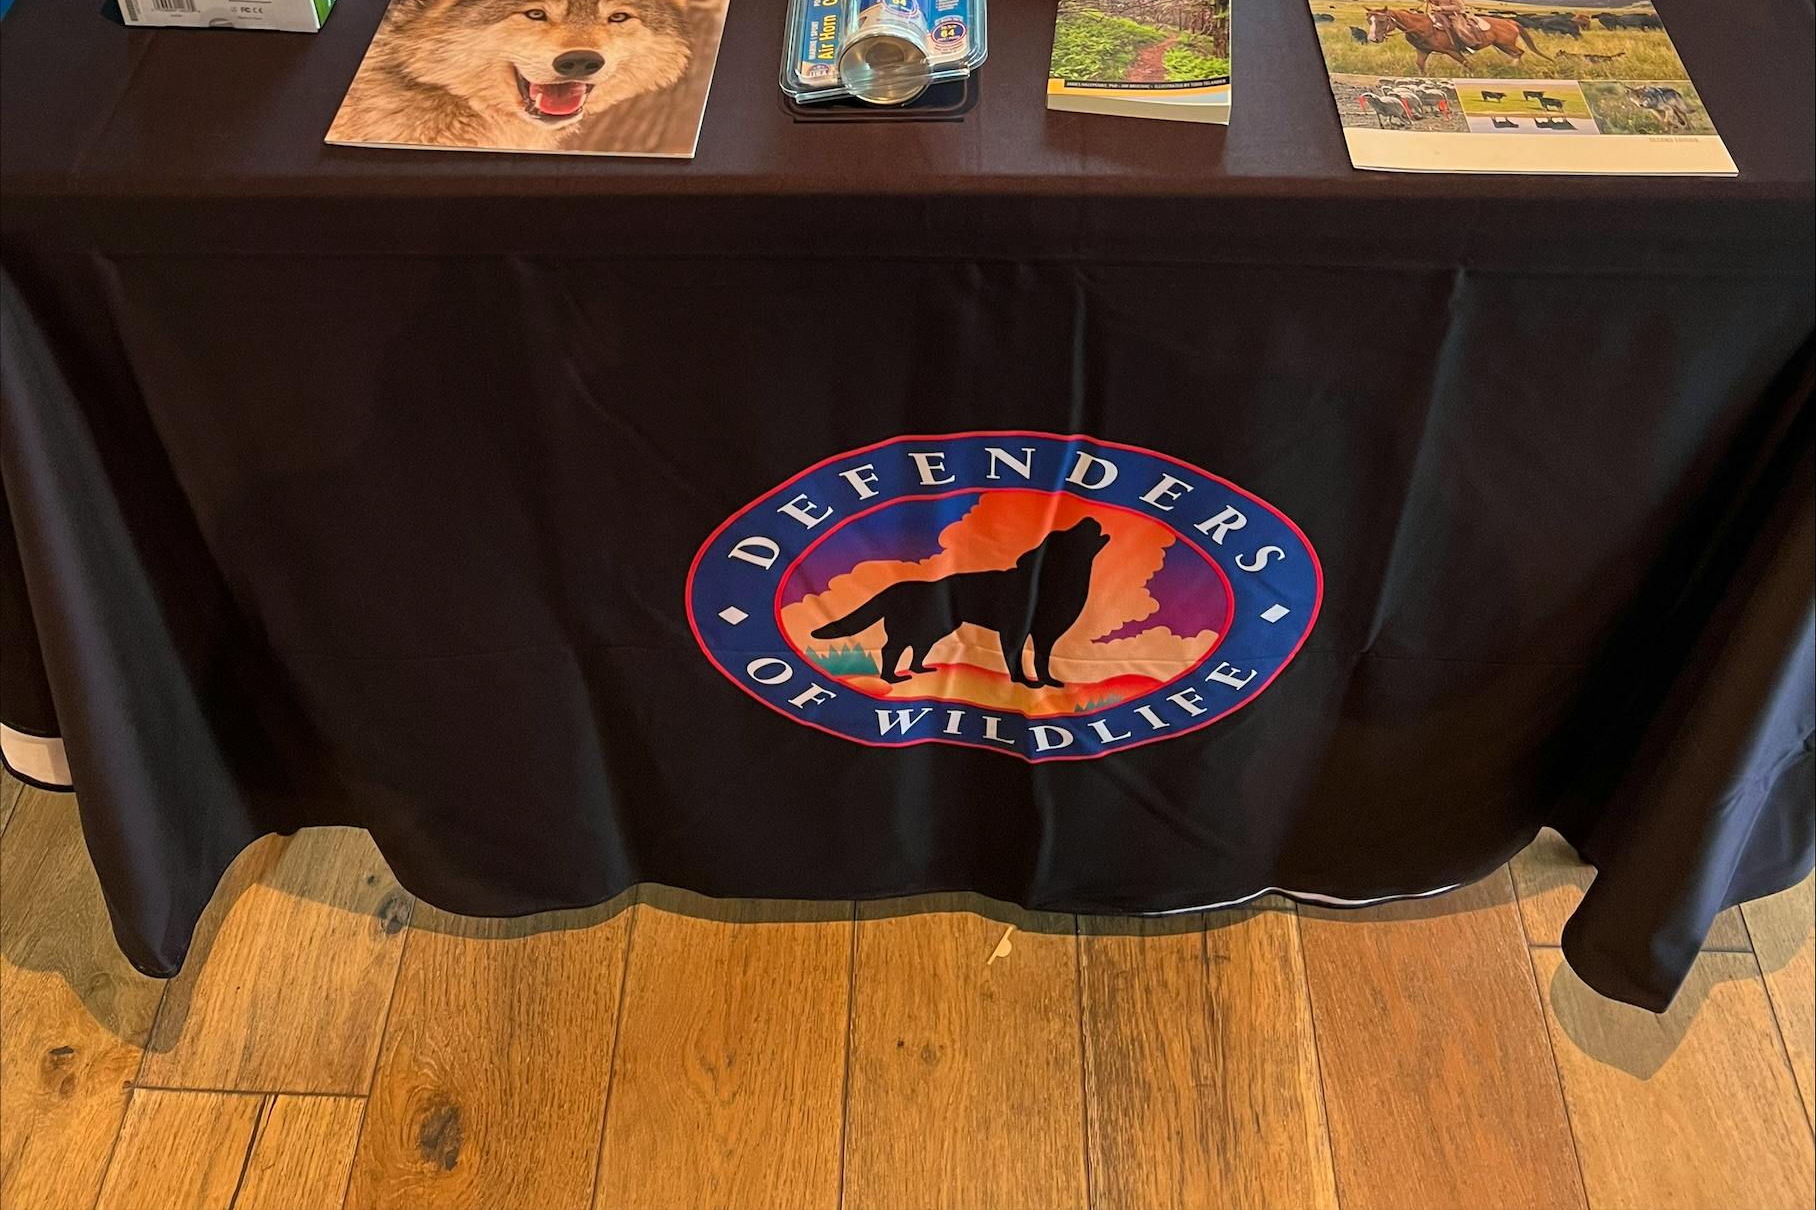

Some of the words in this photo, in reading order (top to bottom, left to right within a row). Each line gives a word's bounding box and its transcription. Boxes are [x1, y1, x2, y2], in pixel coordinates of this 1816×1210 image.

[819, 15, 836, 41] Horn
[940, 28, 955, 37] 64
[817, 43, 835, 60] Air
[728, 446, 1286, 574] DEFENDERS
[746, 657, 836, 709] OF
[874, 661, 1258, 752] WILDLIFE
